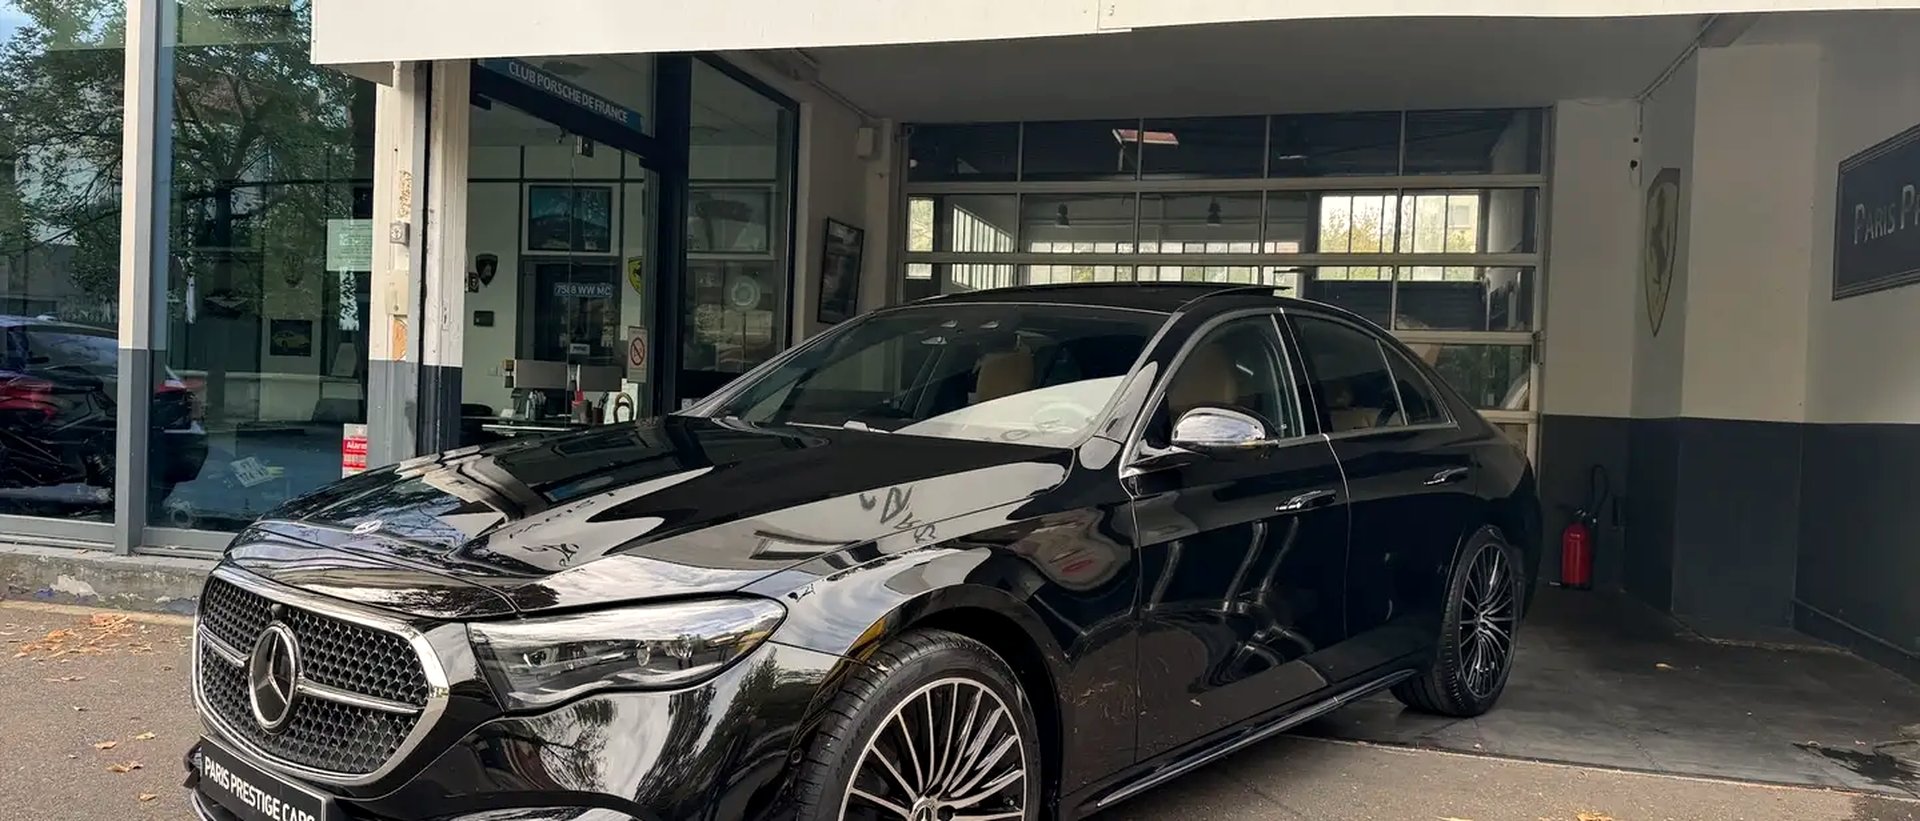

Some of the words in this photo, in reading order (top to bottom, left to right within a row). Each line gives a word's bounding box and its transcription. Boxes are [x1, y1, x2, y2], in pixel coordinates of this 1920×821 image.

[508, 61, 536, 85] CLUB
[536, 73, 582, 103] PORSCHE
[582, 94, 595, 110] DE
[594, 99, 628, 123] FRANCE
[1854, 203, 1896, 245] PARIS
[204, 755, 231, 790] PARIS
[230, 773, 281, 821] PRESTIGE
